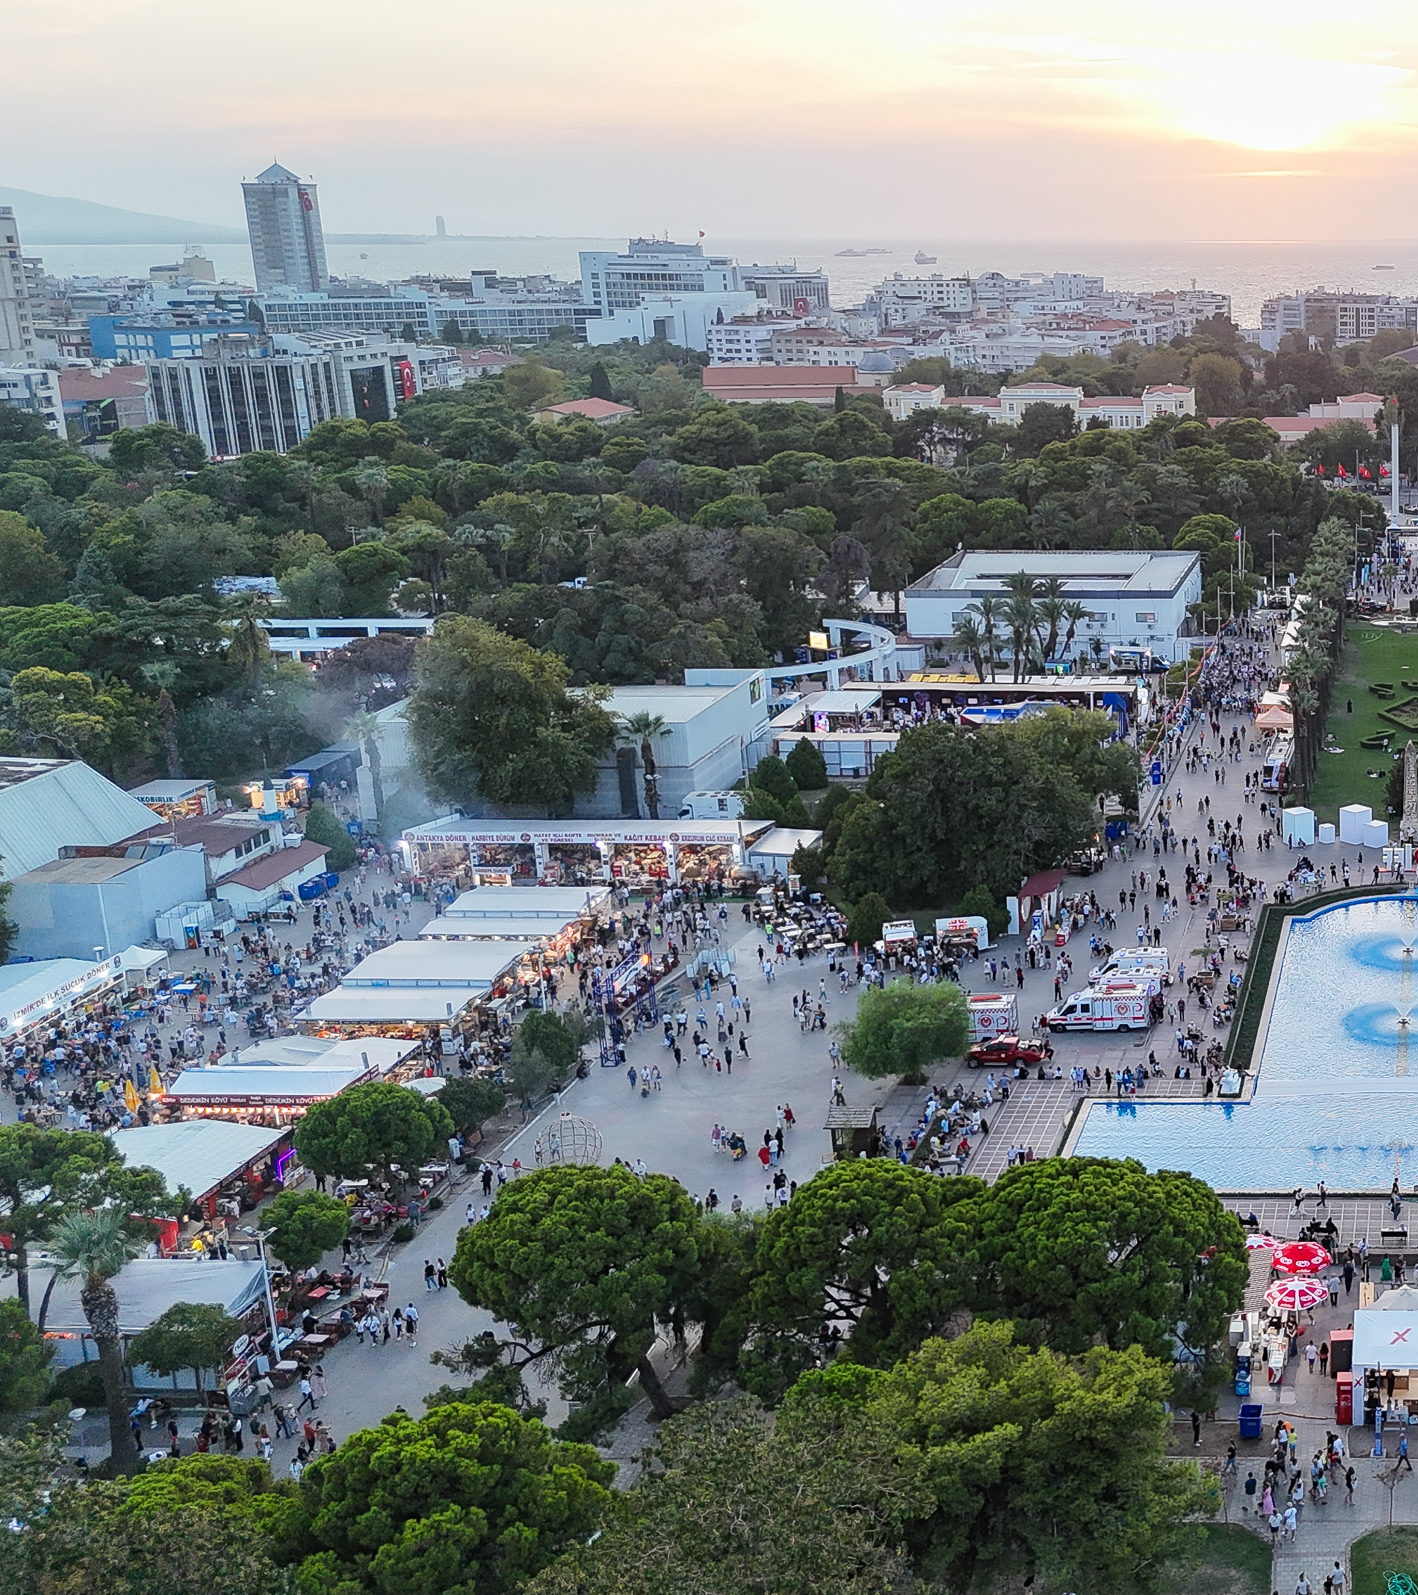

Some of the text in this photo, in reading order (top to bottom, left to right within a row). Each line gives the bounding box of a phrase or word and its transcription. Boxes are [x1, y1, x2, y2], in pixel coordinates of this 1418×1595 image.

[133, 795, 175, 803] SKOBİRLİK
[416, 833, 467, 843] ANTAKYA DÖNER
[471, 834, 516, 842] HARBİYE DÜRÜM
[624, 833, 669, 842] KAĞIT KEBABI
[13, 995, 46, 1020] İZMİR'DE
[47, 989, 60, 1001] İLK
[60, 975, 86, 994] SUCUK
[86, 962, 111, 980] DÖNER
[179, 1096, 210, 1104] DEDEMİN
[210, 1095, 228, 1104] KÖYÜ
